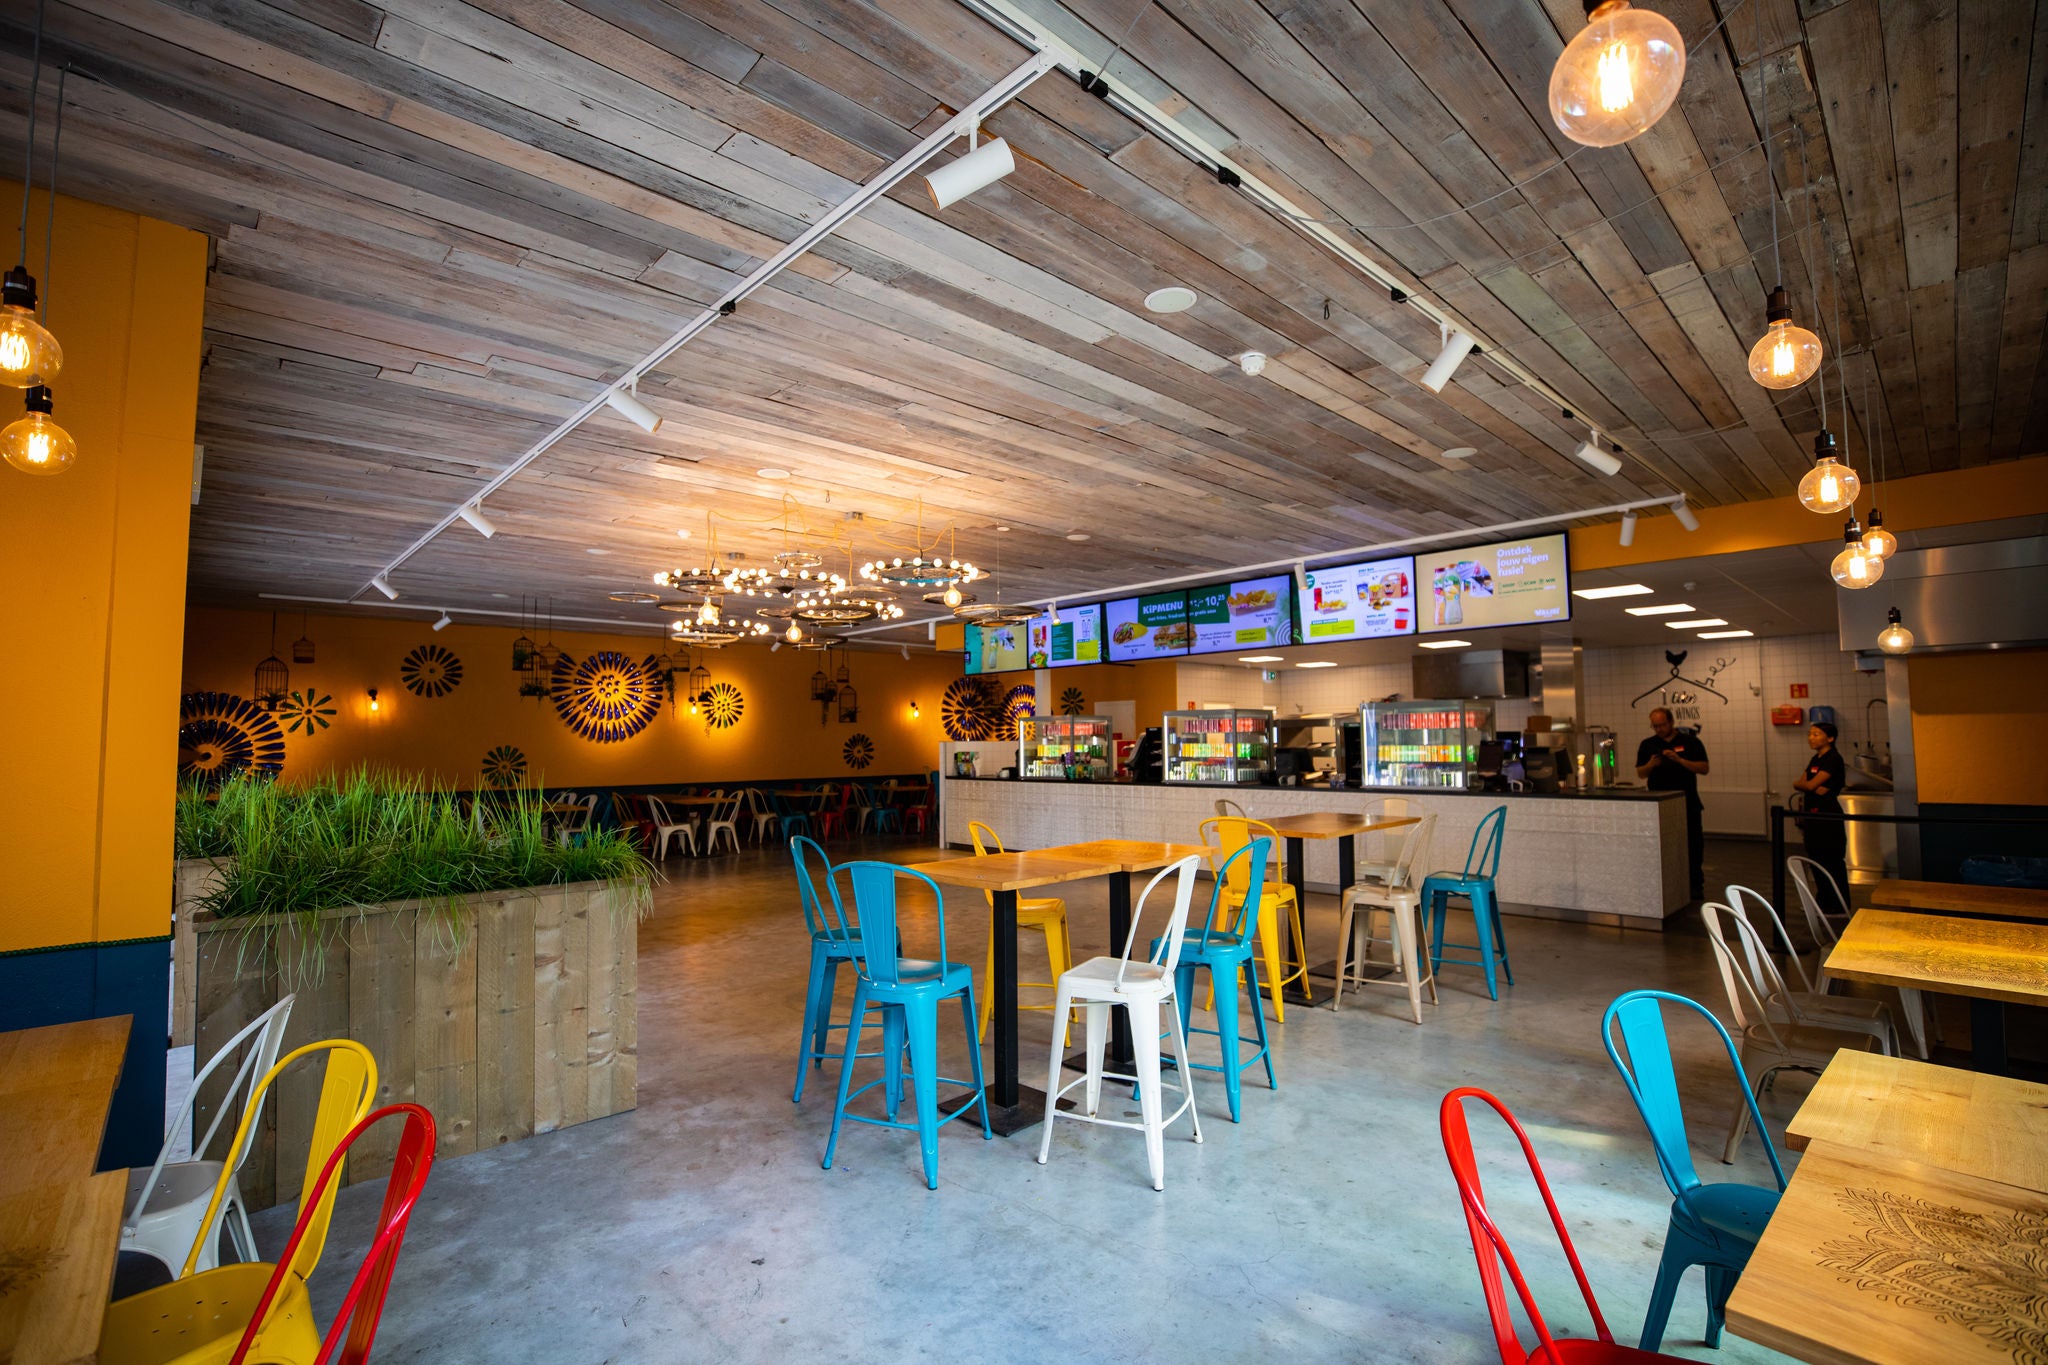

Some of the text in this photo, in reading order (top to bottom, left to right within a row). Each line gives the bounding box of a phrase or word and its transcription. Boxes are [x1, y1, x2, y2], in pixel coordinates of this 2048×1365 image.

[1497, 545, 1532, 557] Ontdek
[1497, 554, 1549, 569] jouw eigen
[1498, 566, 1525, 576] fusie!
[1675, 706, 1701, 720] WINGS
